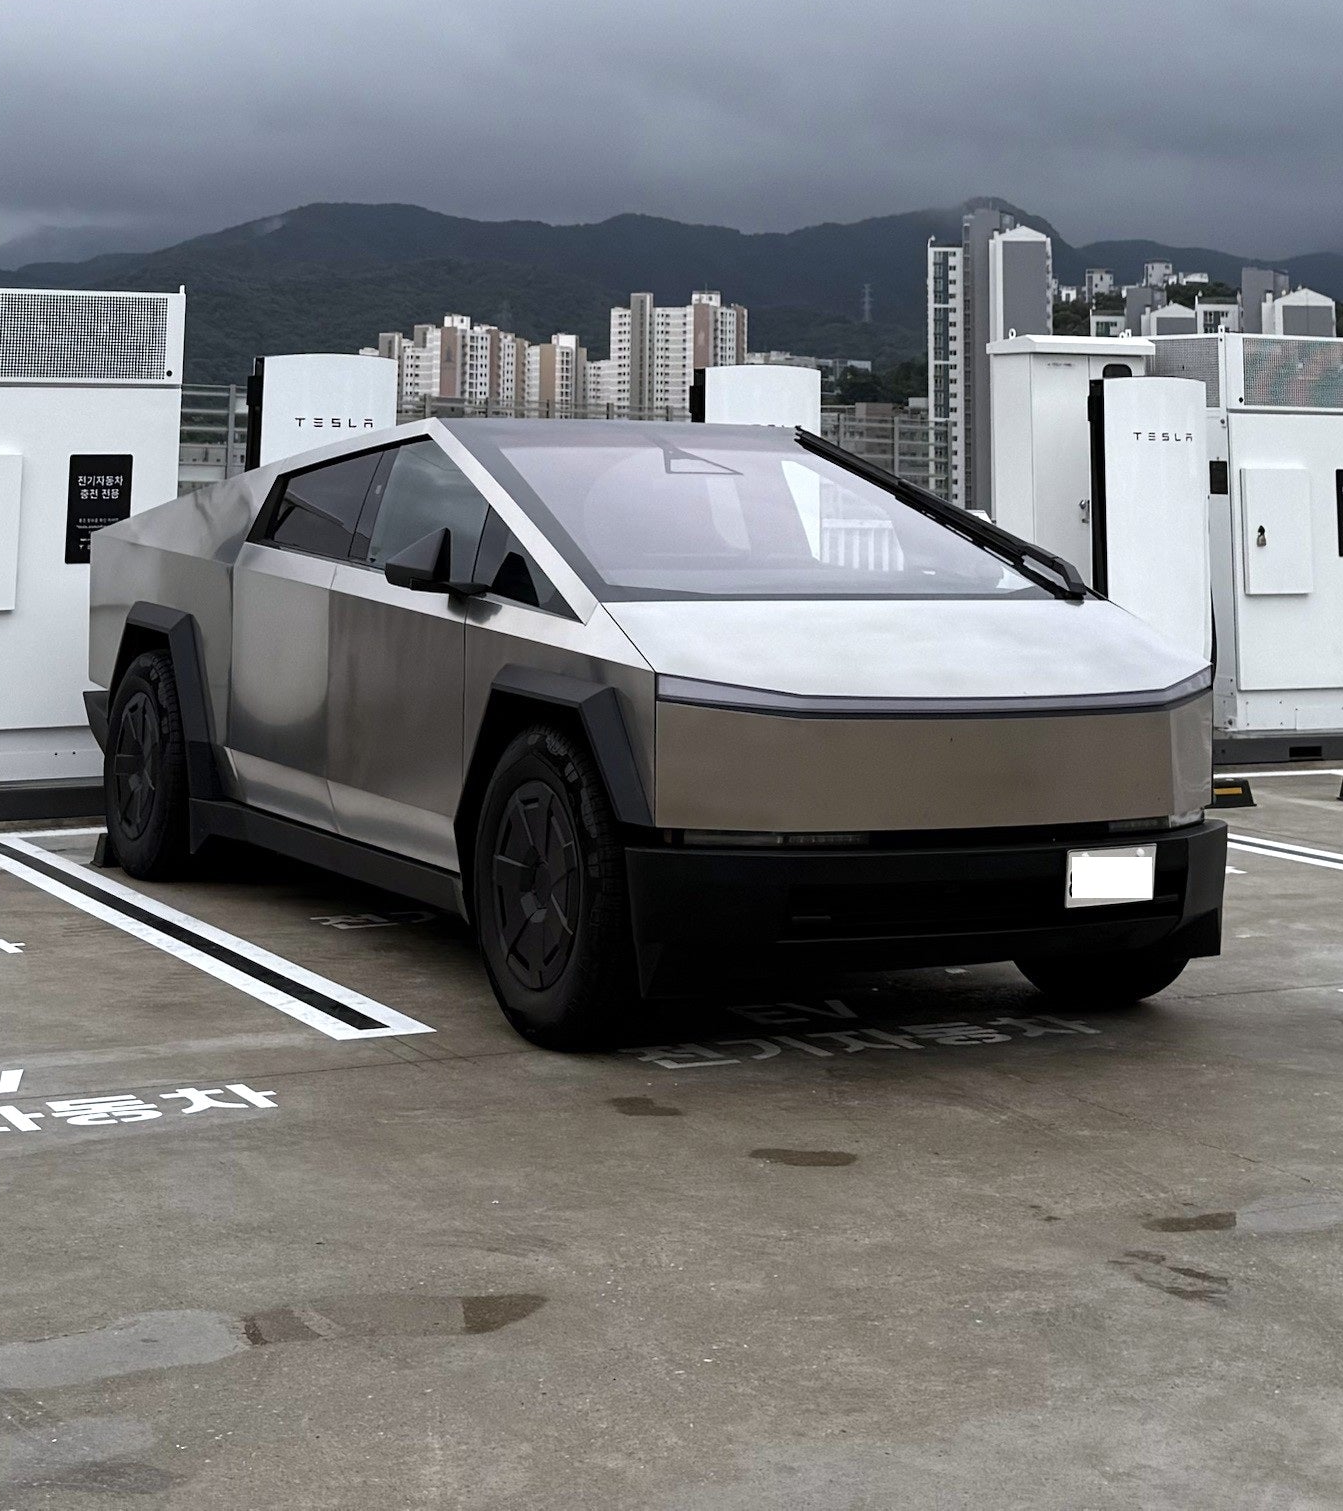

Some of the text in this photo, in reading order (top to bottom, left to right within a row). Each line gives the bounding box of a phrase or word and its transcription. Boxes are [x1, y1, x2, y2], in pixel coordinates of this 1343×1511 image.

[294, 417, 374, 429] TESLA
[1132, 431, 1193, 442] TESLA
[77, 475, 123, 487] 전기자동차
[618, 1014, 1102, 1069] 전기자동차
